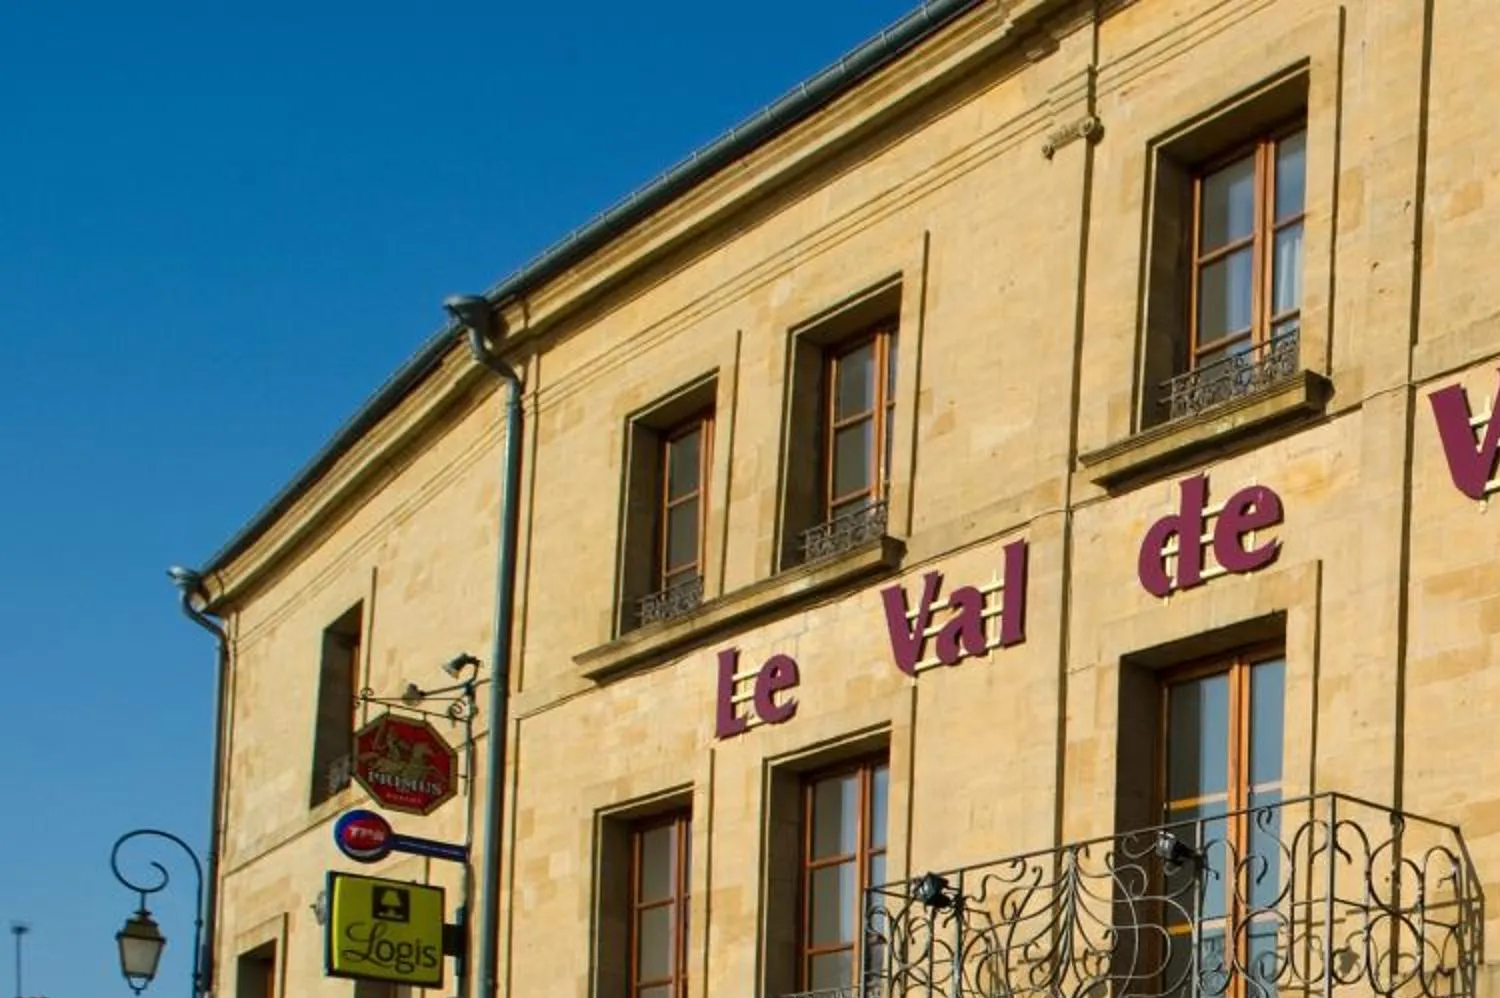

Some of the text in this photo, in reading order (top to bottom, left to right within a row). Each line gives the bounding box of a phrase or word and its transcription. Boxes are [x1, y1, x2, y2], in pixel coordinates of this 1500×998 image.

[715, 647, 799, 738] Le
[882, 540, 1028, 677] Val
[1138, 474, 1283, 597] de
[342, 921, 437, 975] Logis
